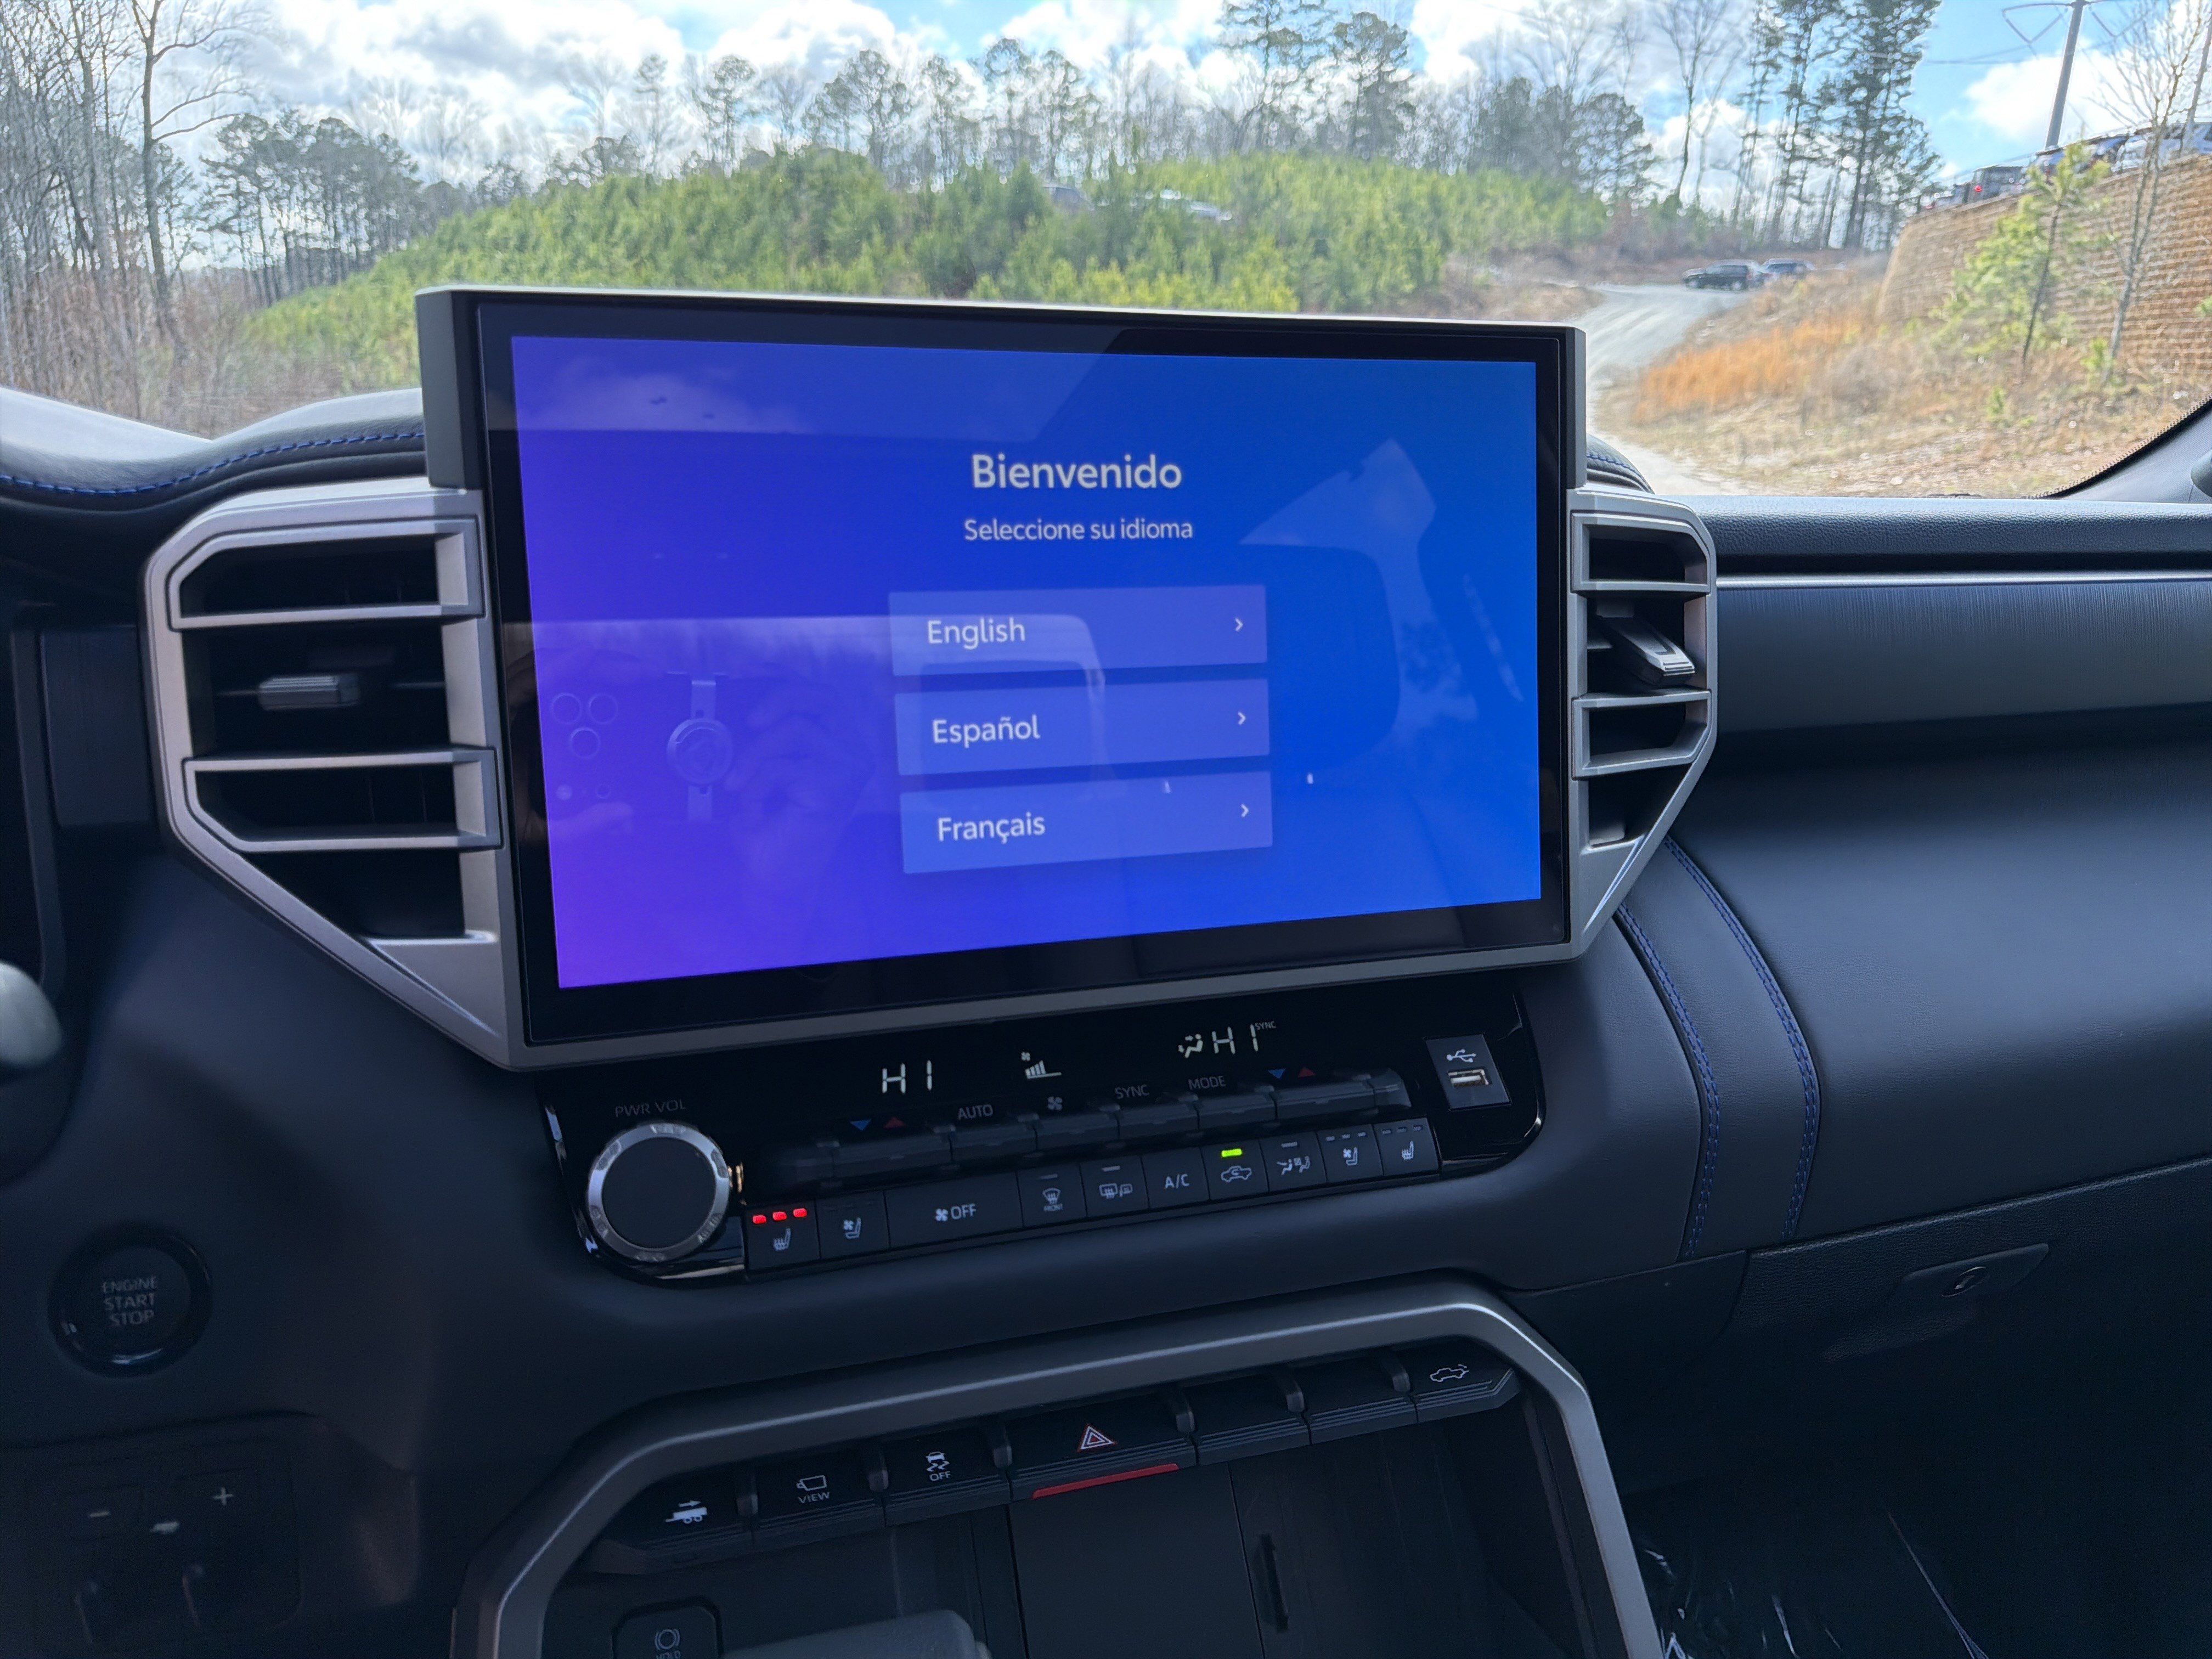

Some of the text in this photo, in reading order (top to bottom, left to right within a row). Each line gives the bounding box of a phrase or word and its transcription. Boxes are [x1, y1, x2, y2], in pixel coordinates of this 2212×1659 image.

[971, 453, 1183, 489] Bienvenido
[964, 518, 1194, 541] Seleccione su idioma
[927, 618, 1026, 650] English
[932, 715, 1041, 748] Español
[936, 812, 1046, 844] Français
[1255, 1021, 1277, 1030] SYNC
[1115, 1085, 1149, 1098] SYNC
[1188, 1076, 1226, 1090] MODE
[615, 1098, 686, 1118] PWR VOL
[958, 1104, 993, 1120] AUTO
[1165, 1174, 1189, 1189] A/C
[951, 1203, 976, 1220] OFF
[101, 1276, 156, 1293] ENGINE
[104, 1293, 154, 1311] START
[109, 1310, 154, 1327] STOP
[929, 1471, 951, 1481] OFF
[798, 1492, 830, 1503] VIEW
